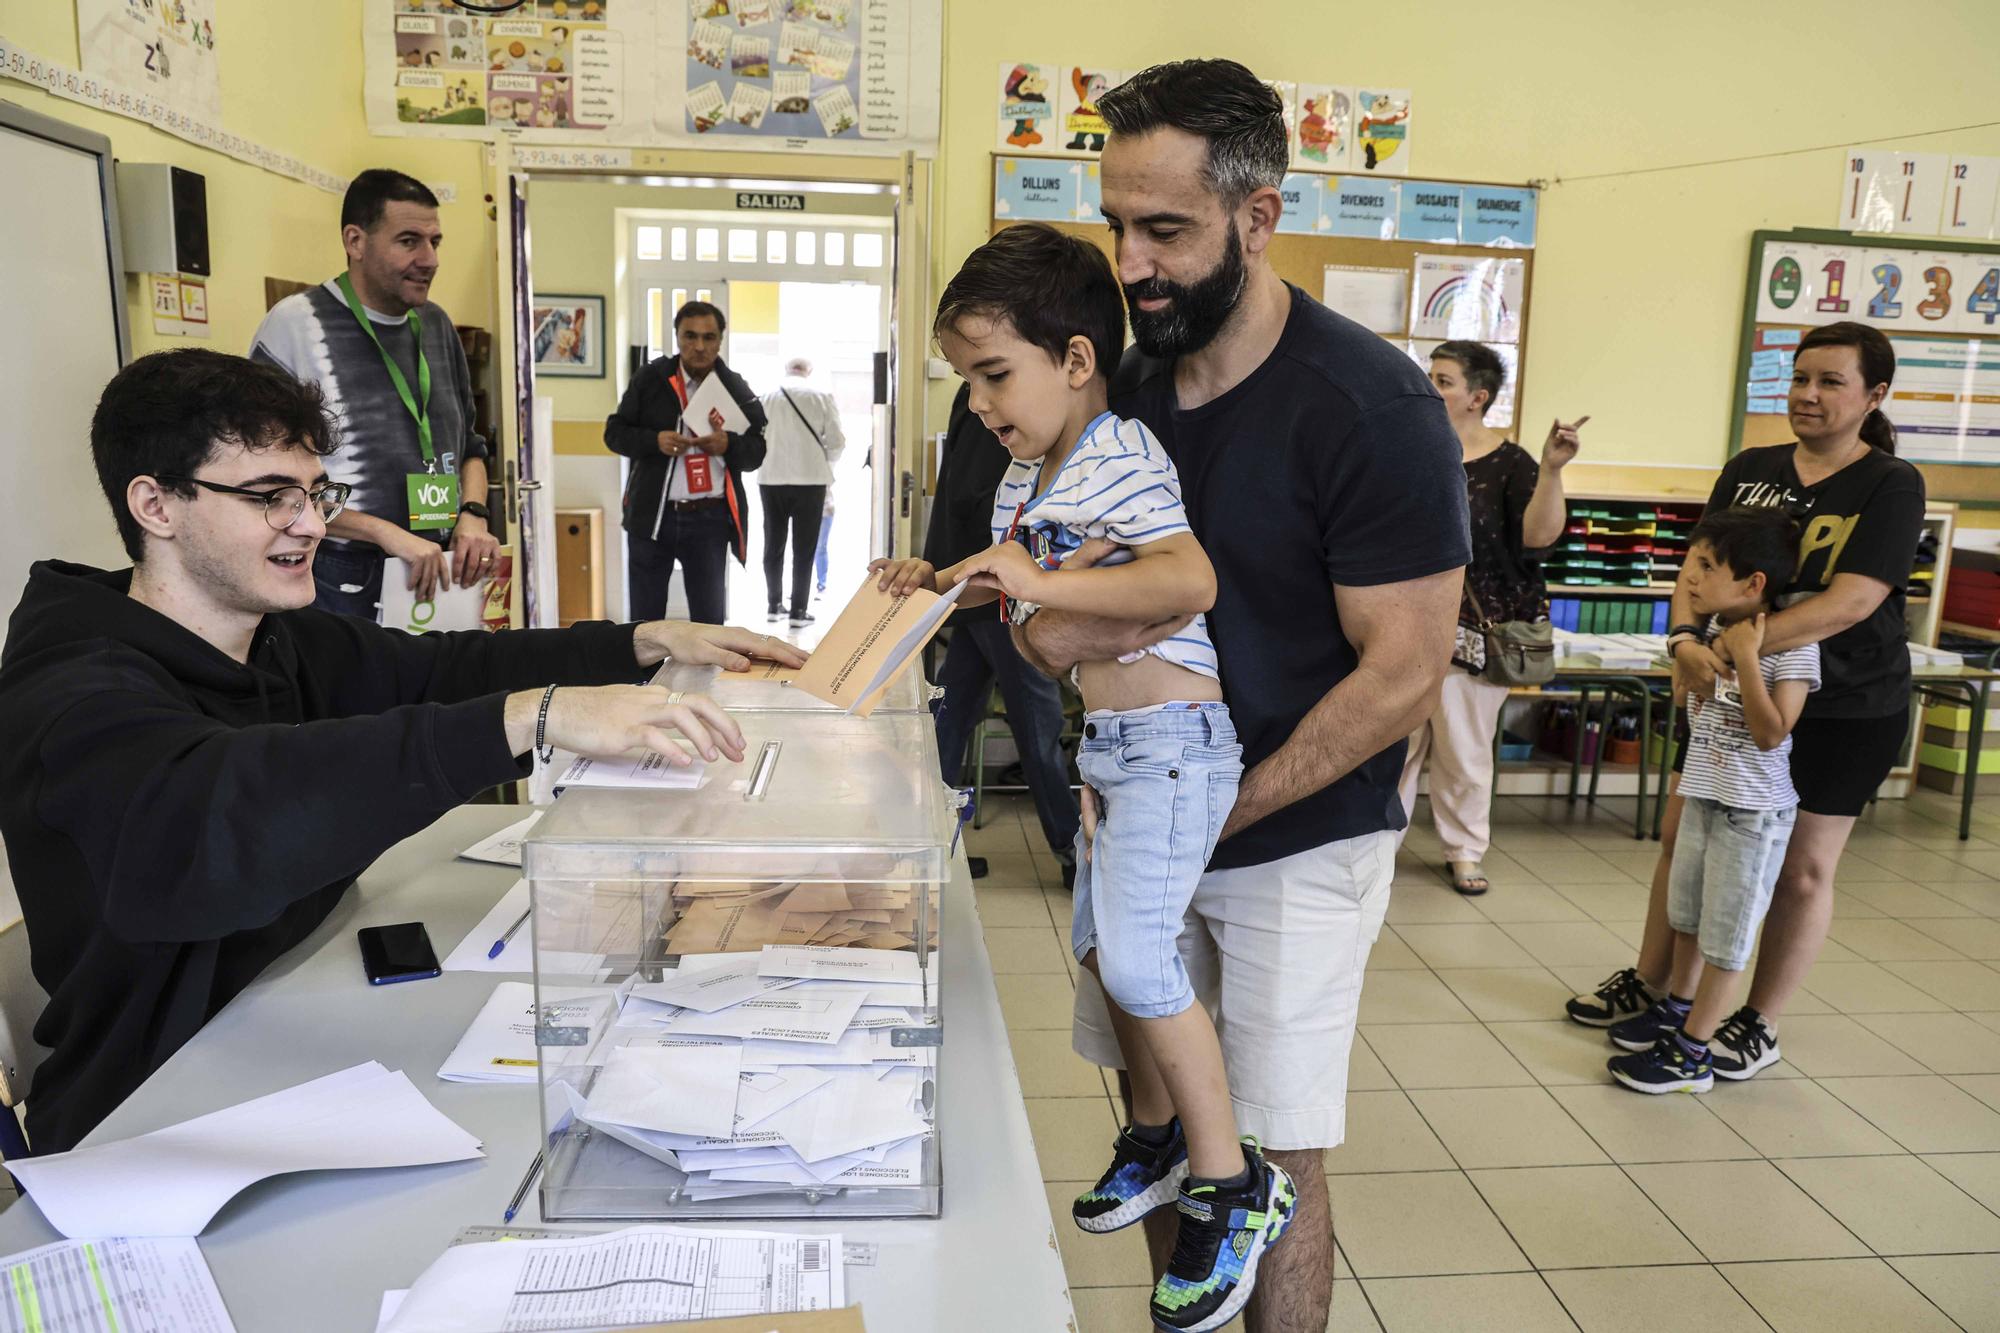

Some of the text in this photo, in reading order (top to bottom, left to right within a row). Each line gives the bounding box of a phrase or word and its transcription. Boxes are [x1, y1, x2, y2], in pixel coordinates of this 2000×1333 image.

[1851, 158, 1968, 179] 10 11 12
[1022, 177, 1061, 190] DILLUNS
[739, 194, 803, 209] SALIDA
[1281, 191, 1300, 203] OUS
[1340, 194, 1384, 208] DIVENDRES
[1416, 193, 1459, 208] DISSABTE
[1477, 198, 1521, 212] DIUMENGE
[1816, 260, 1849, 313] 1
[1867, 264, 1902, 319] 2
[1917, 266, 1952, 320] 3
[417, 483, 449, 507] VOX
[866, 631, 881, 649] CORTS
[840, 648, 868, 682] VALENCIANES
[785, 1032, 828, 1040] ELECCIONES
